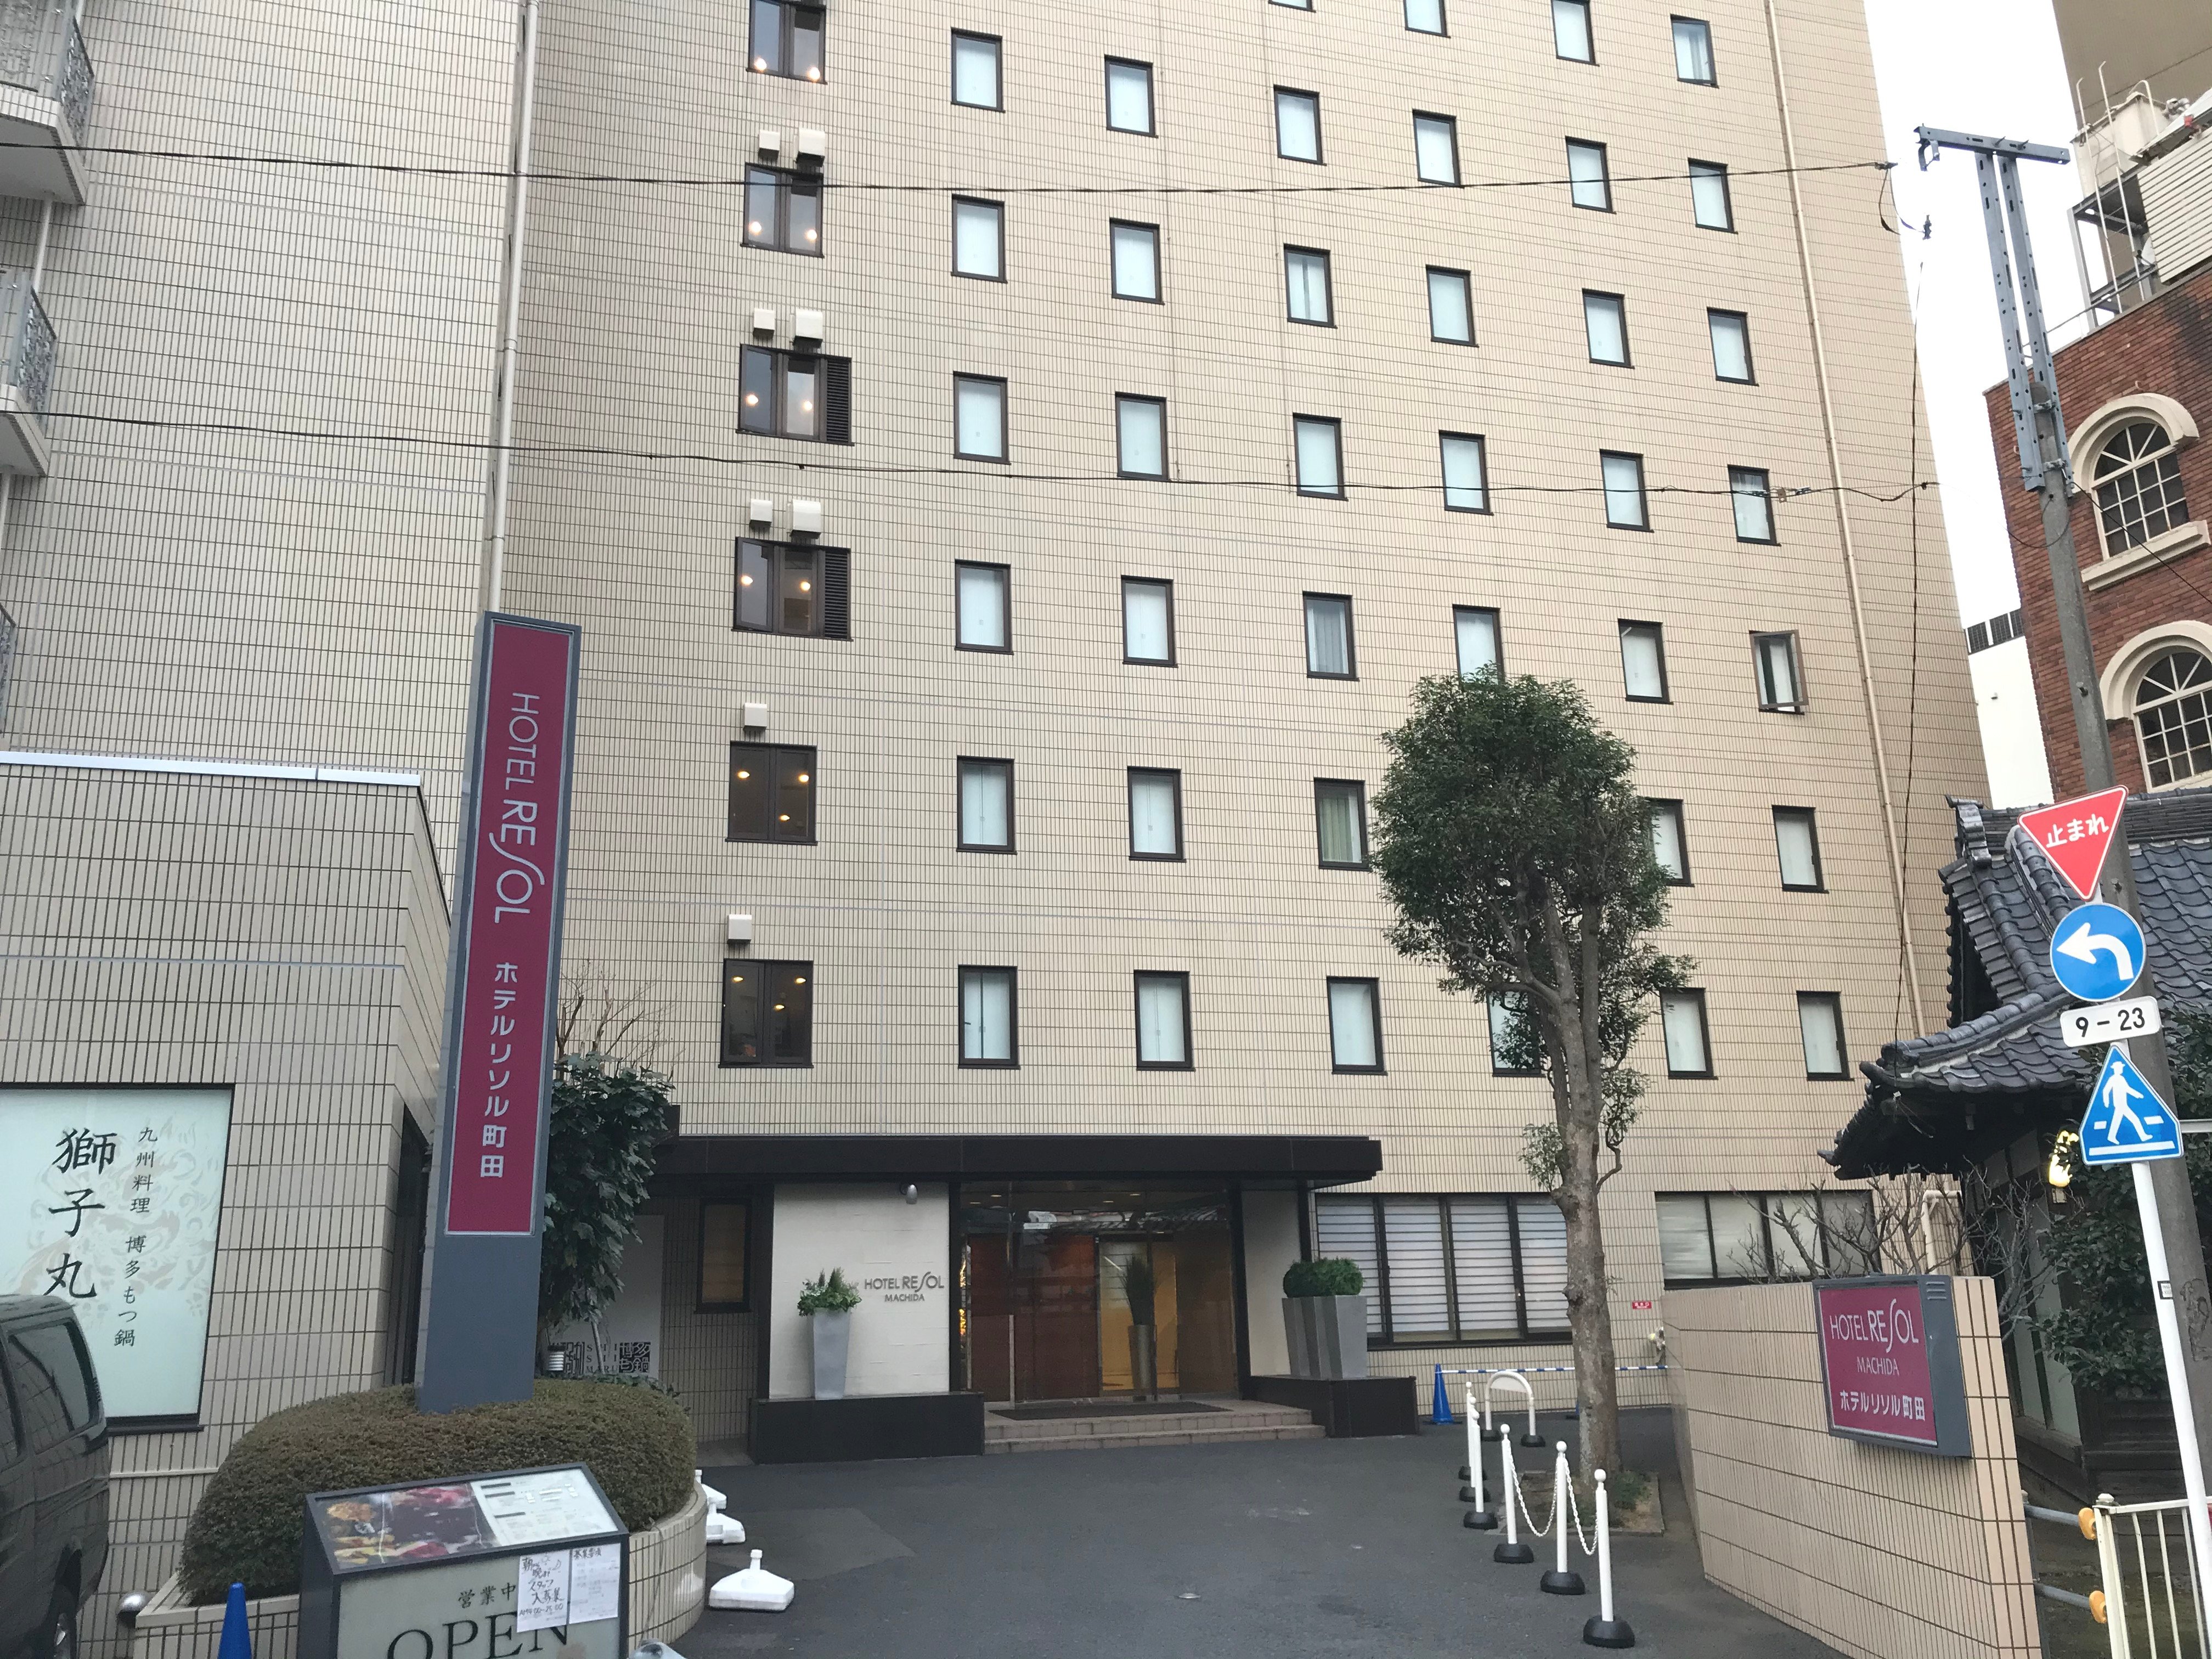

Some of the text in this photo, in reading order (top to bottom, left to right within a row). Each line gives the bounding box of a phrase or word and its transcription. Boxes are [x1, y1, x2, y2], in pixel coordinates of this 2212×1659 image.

[489, 692, 545, 924] HOTEL RESOL
[2045, 812, 2110, 849] 止まれ
[480, 962, 518, 1178] ホテルリソル町田
[43, 1127, 117, 1300] 獅子丸
[114, 1126, 158, 1347] 九州料理 博多もつ鍋
[865, 1271, 945, 1293] HOTEL RESOL
[884, 1294, 925, 1302] MACHIDA
[1829, 1298, 1919, 1353] HOTEL RESOL
[1857, 1356, 1900, 1376] MACHIDA
[1839, 1390, 1926, 1421] ホテルリソル町田
[458, 1582, 516, 1609] 営業中
